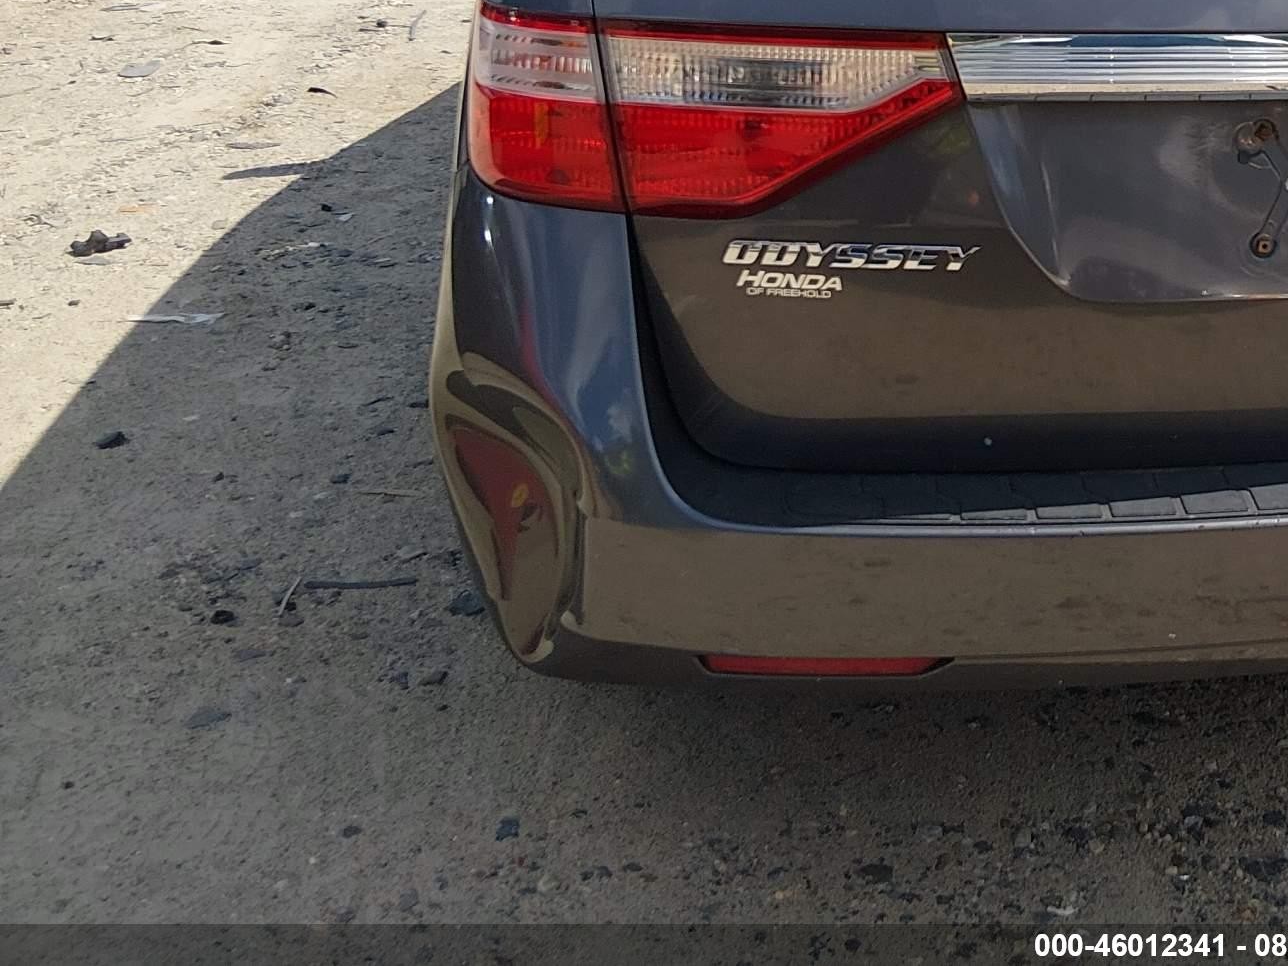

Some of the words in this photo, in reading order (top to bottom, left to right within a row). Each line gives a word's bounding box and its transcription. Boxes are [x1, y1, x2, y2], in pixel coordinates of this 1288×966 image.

[722, 239, 982, 272] ODYSSEY
[736, 269, 843, 291] HONDA
[746, 287, 765, 296] OF
[766, 288, 832, 299] FREEHOLD
